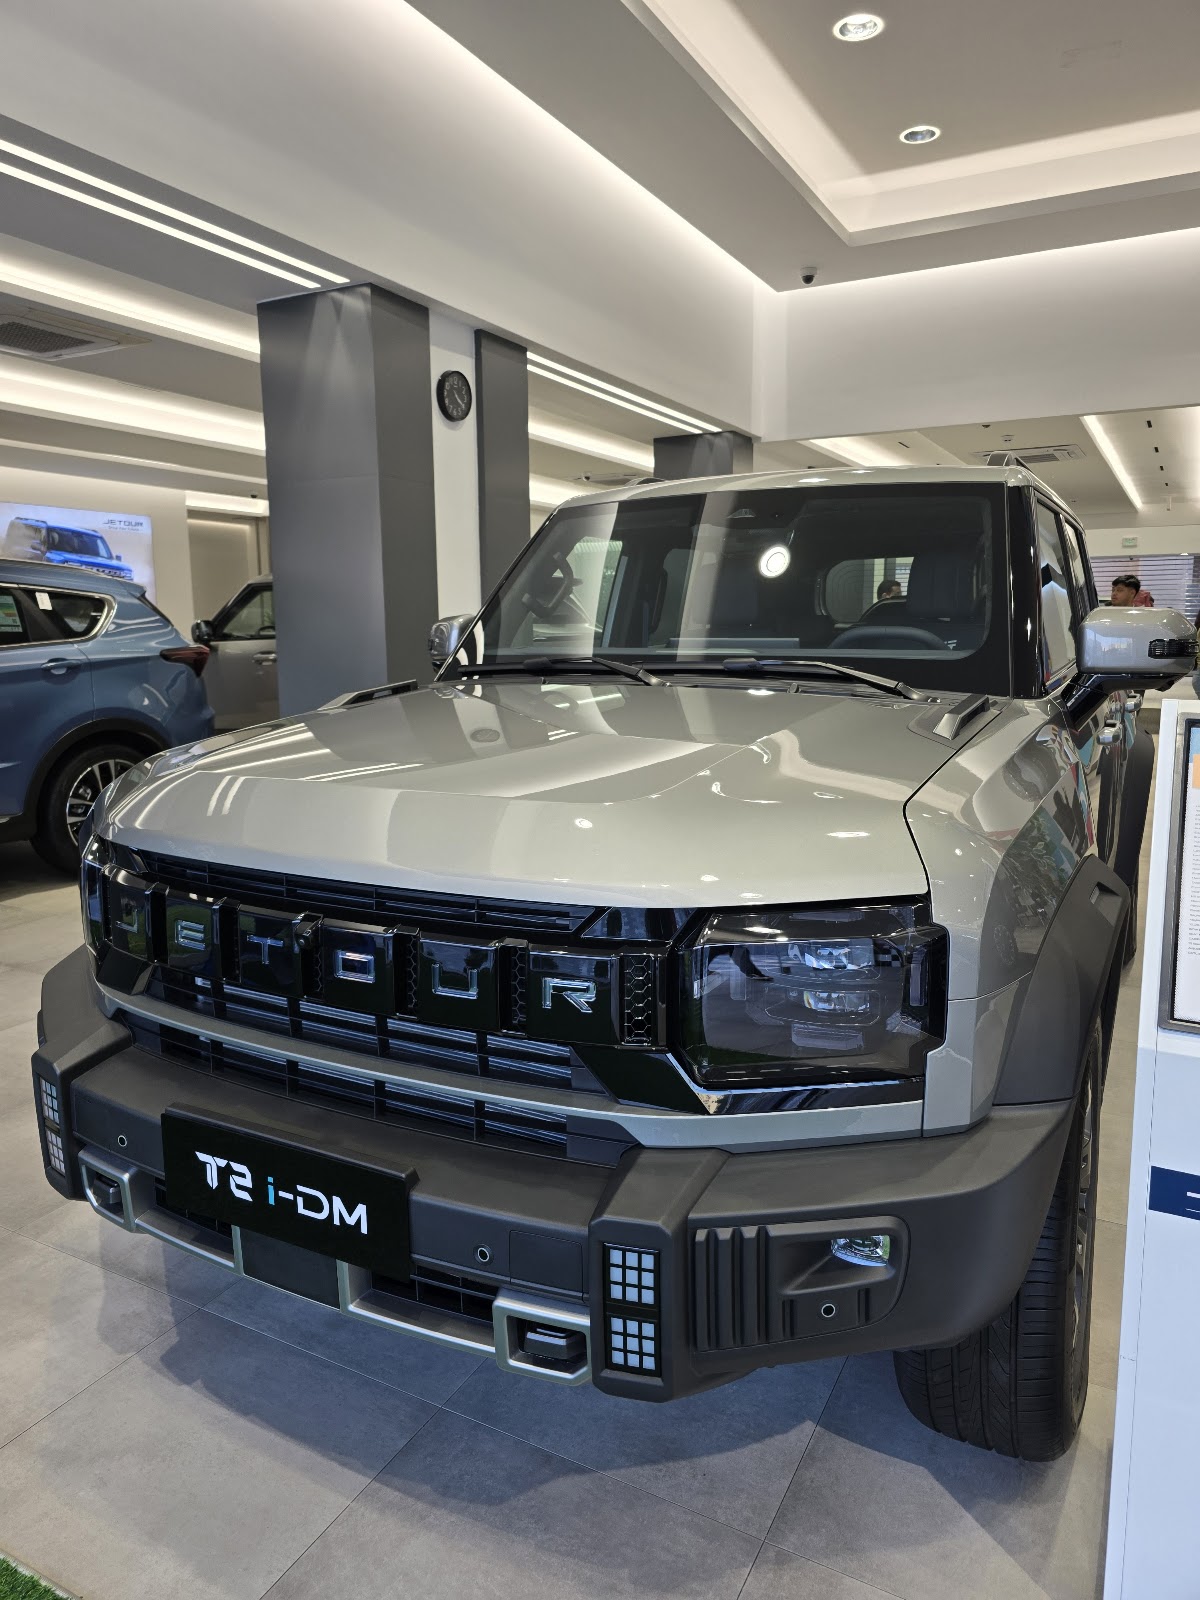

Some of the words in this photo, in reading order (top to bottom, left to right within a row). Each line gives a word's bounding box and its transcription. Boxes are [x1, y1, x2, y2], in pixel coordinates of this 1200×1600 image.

[103, 519, 144, 527] JETOUR
[115, 908, 597, 1013] JETOUR
[195, 1151, 253, 1202] T2
[267, 1176, 368, 1235] i-DM
